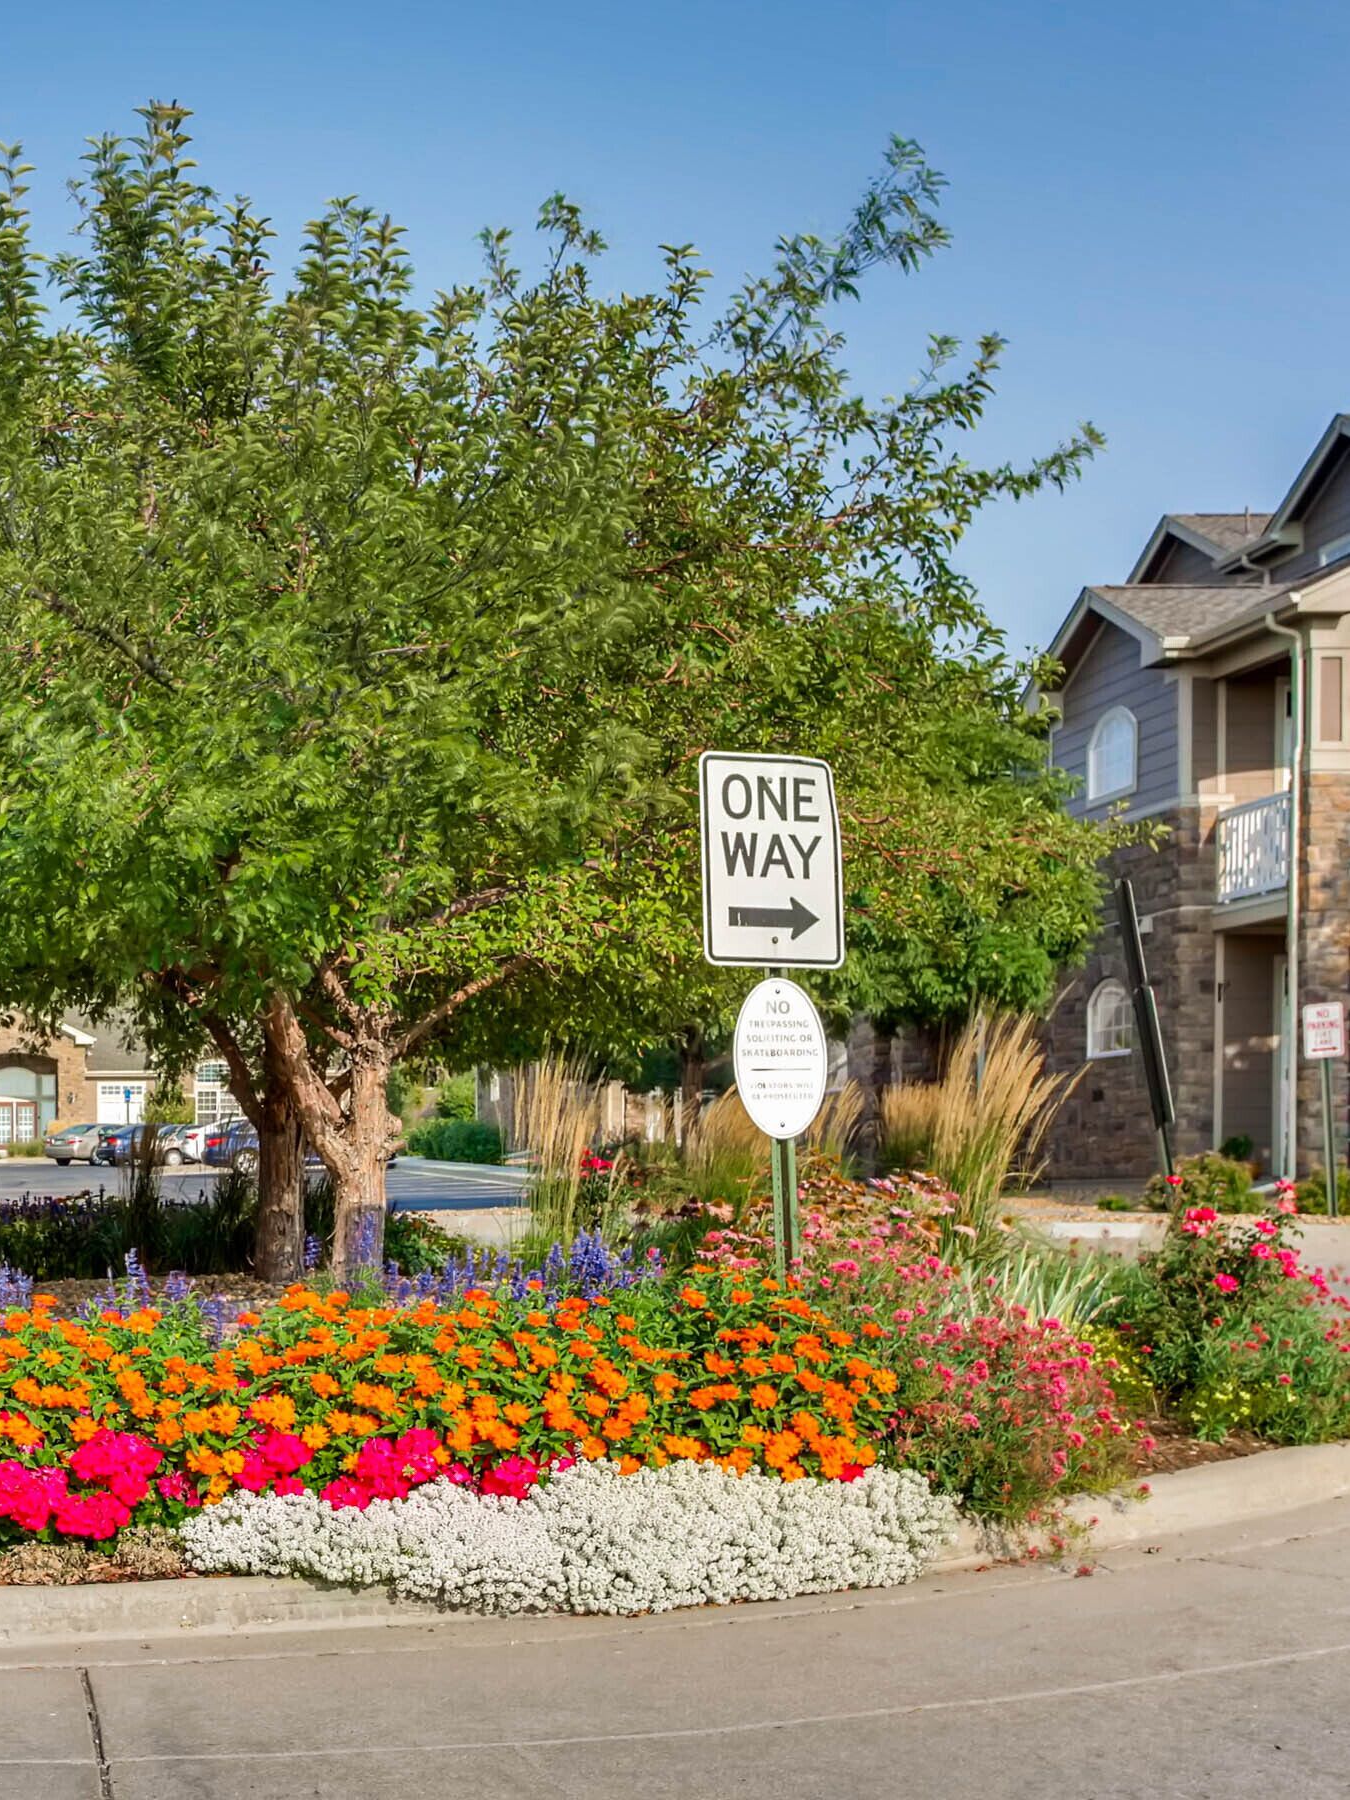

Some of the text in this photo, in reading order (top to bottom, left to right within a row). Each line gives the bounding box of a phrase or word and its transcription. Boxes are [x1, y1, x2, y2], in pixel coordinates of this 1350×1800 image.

[721, 773, 820, 823] ONE
[720, 831, 822, 880] WAY
[765, 1000, 791, 1015] NO
[799, 1033, 813, 1043] OR
[741, 1048, 819, 1058] SKATEBOARDING
